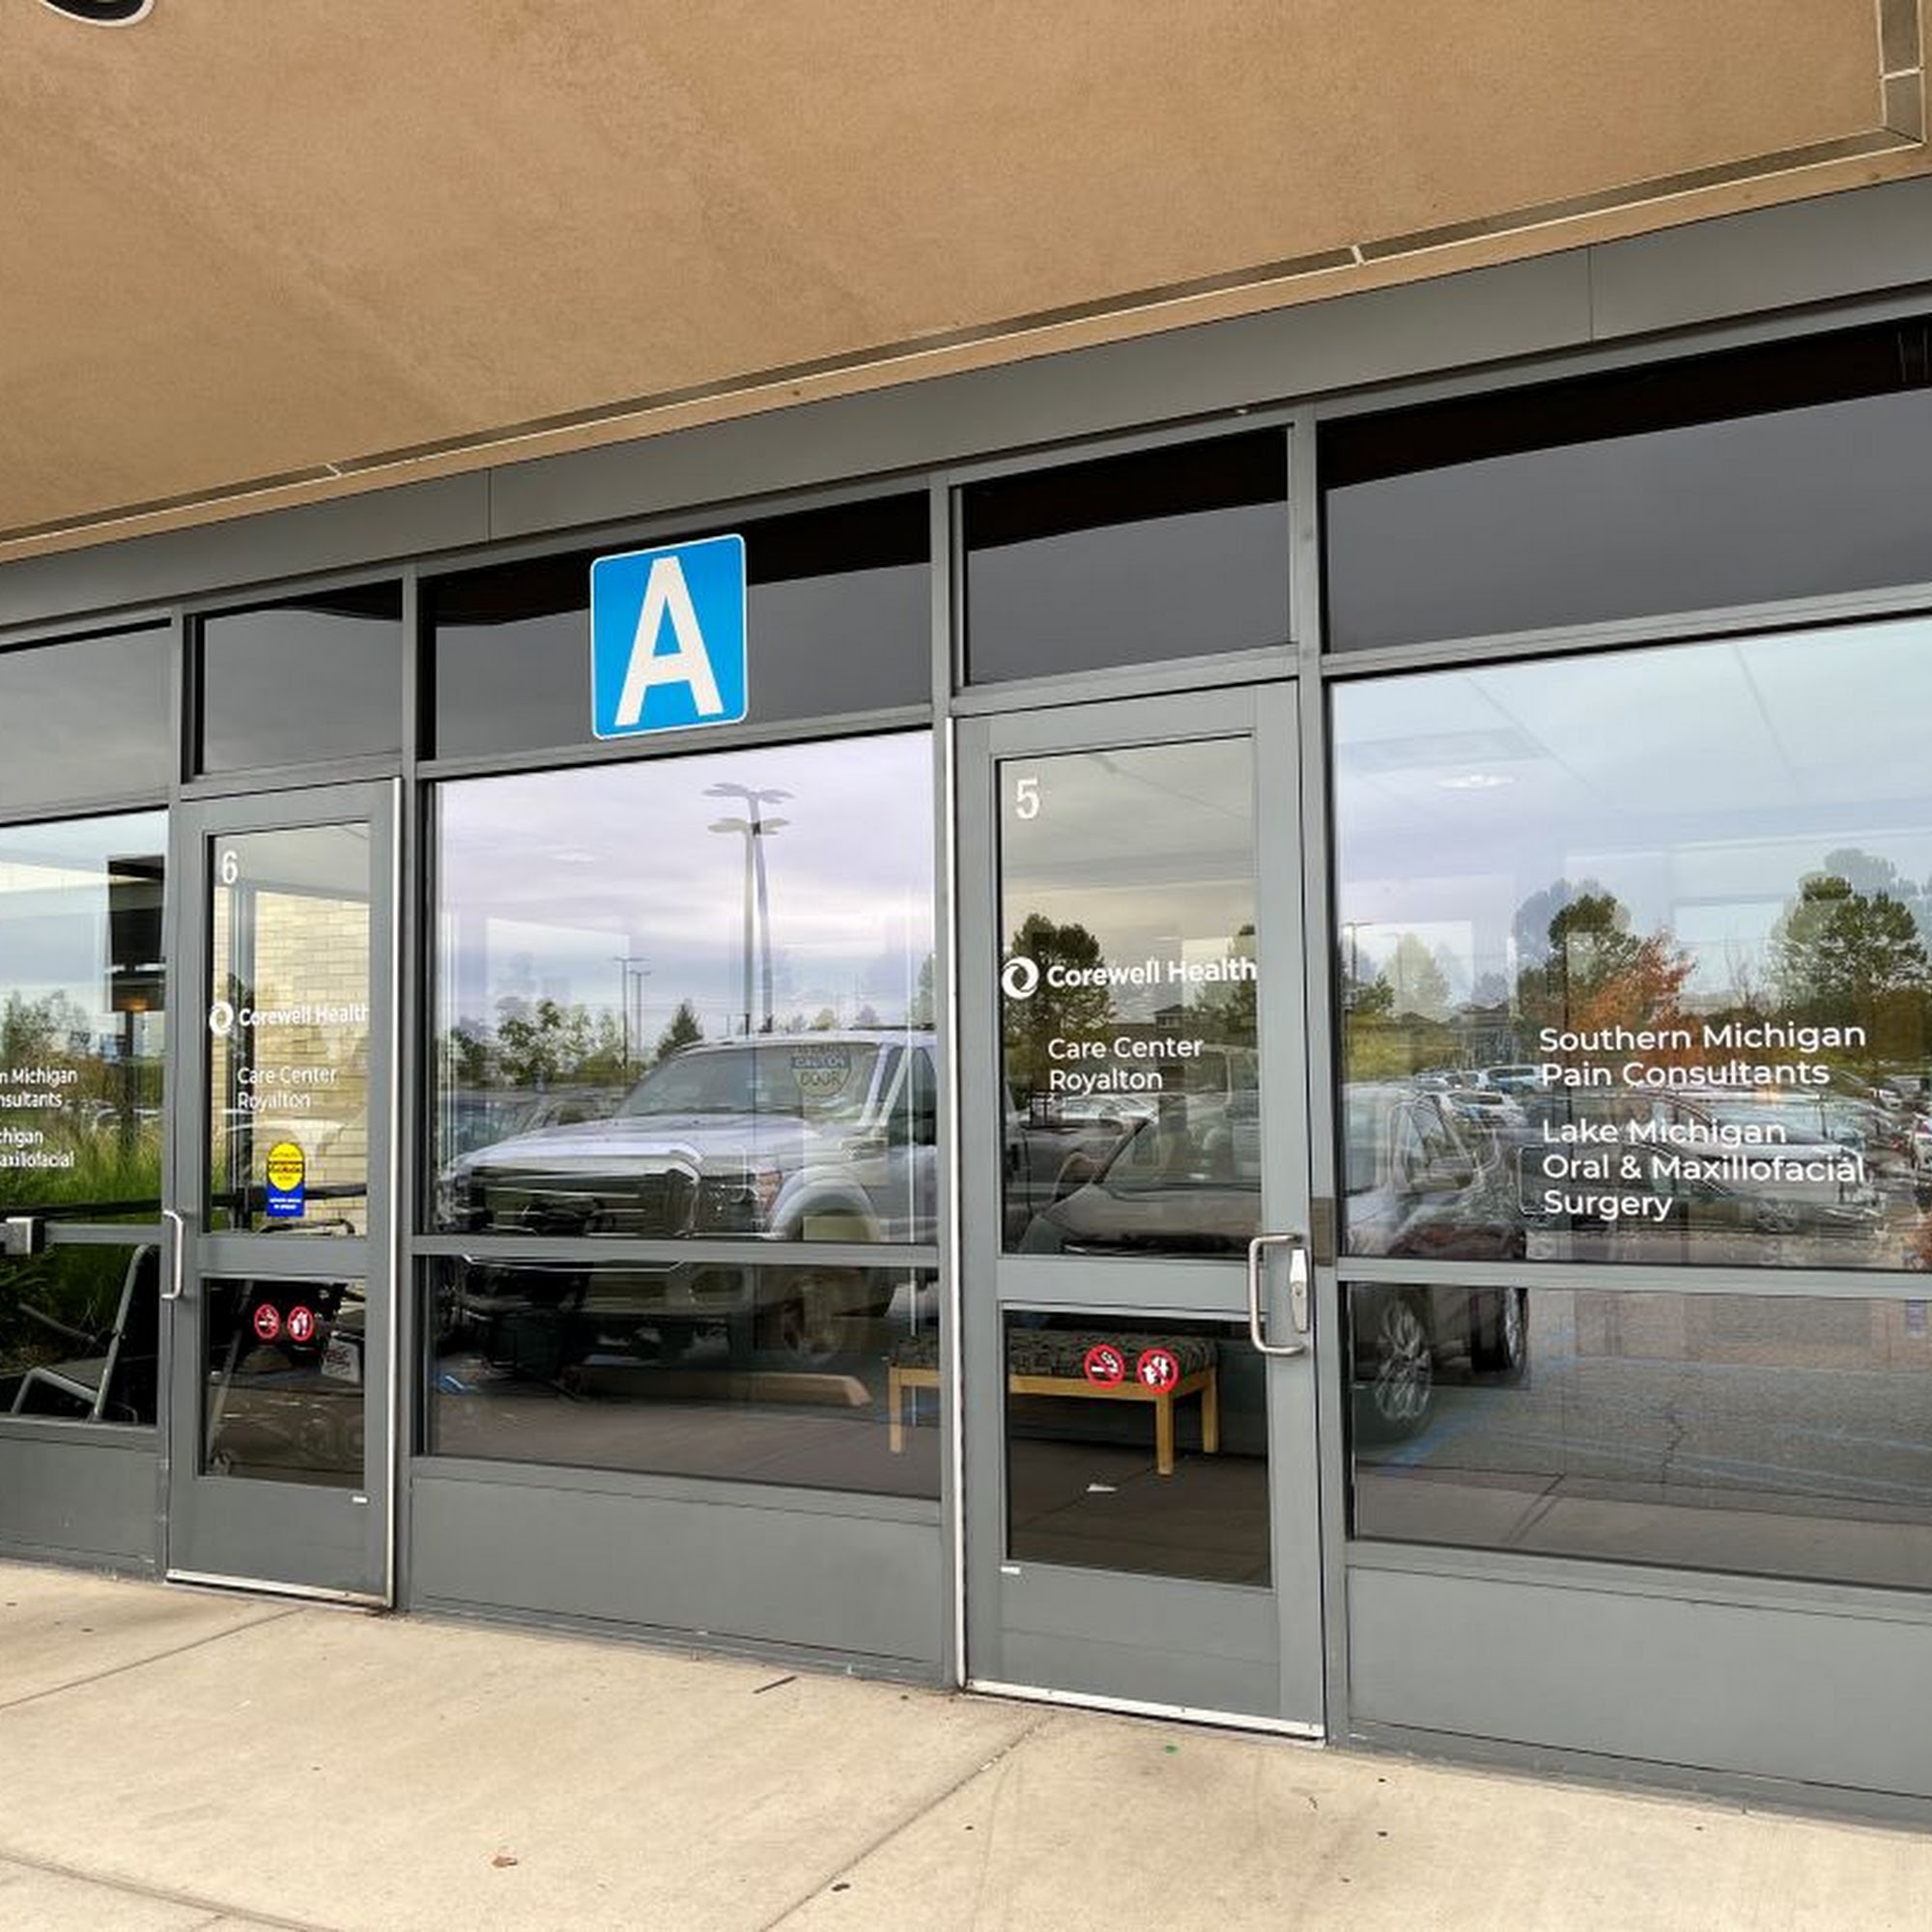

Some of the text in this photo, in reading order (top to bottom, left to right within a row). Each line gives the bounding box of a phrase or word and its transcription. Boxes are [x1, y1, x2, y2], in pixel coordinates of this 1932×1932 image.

[615, 555, 724, 726] A
[1015, 777, 1040, 819] 5
[221, 850, 239, 884] 6
[1046, 955, 1258, 988] Corewell Health
[239, 1006, 311, 1027] Corewell
[1048, 1036, 1205, 1061] Care Center
[1539, 1021, 1866, 1054] Southern Michigan
[12, 1067, 78, 1089] Michigan
[238, 1065, 337, 1085] Care Center
[1049, 1067, 1163, 1096] Royalton
[1542, 1059, 1831, 1088] Pain Consultants
[238, 1093, 310, 1112] Royalton
[1543, 1117, 1787, 1149] Lake Michigan
[1543, 1154, 1865, 1182] Oral & Maxillofacial
[1545, 1189, 1673, 1222] Surgery
